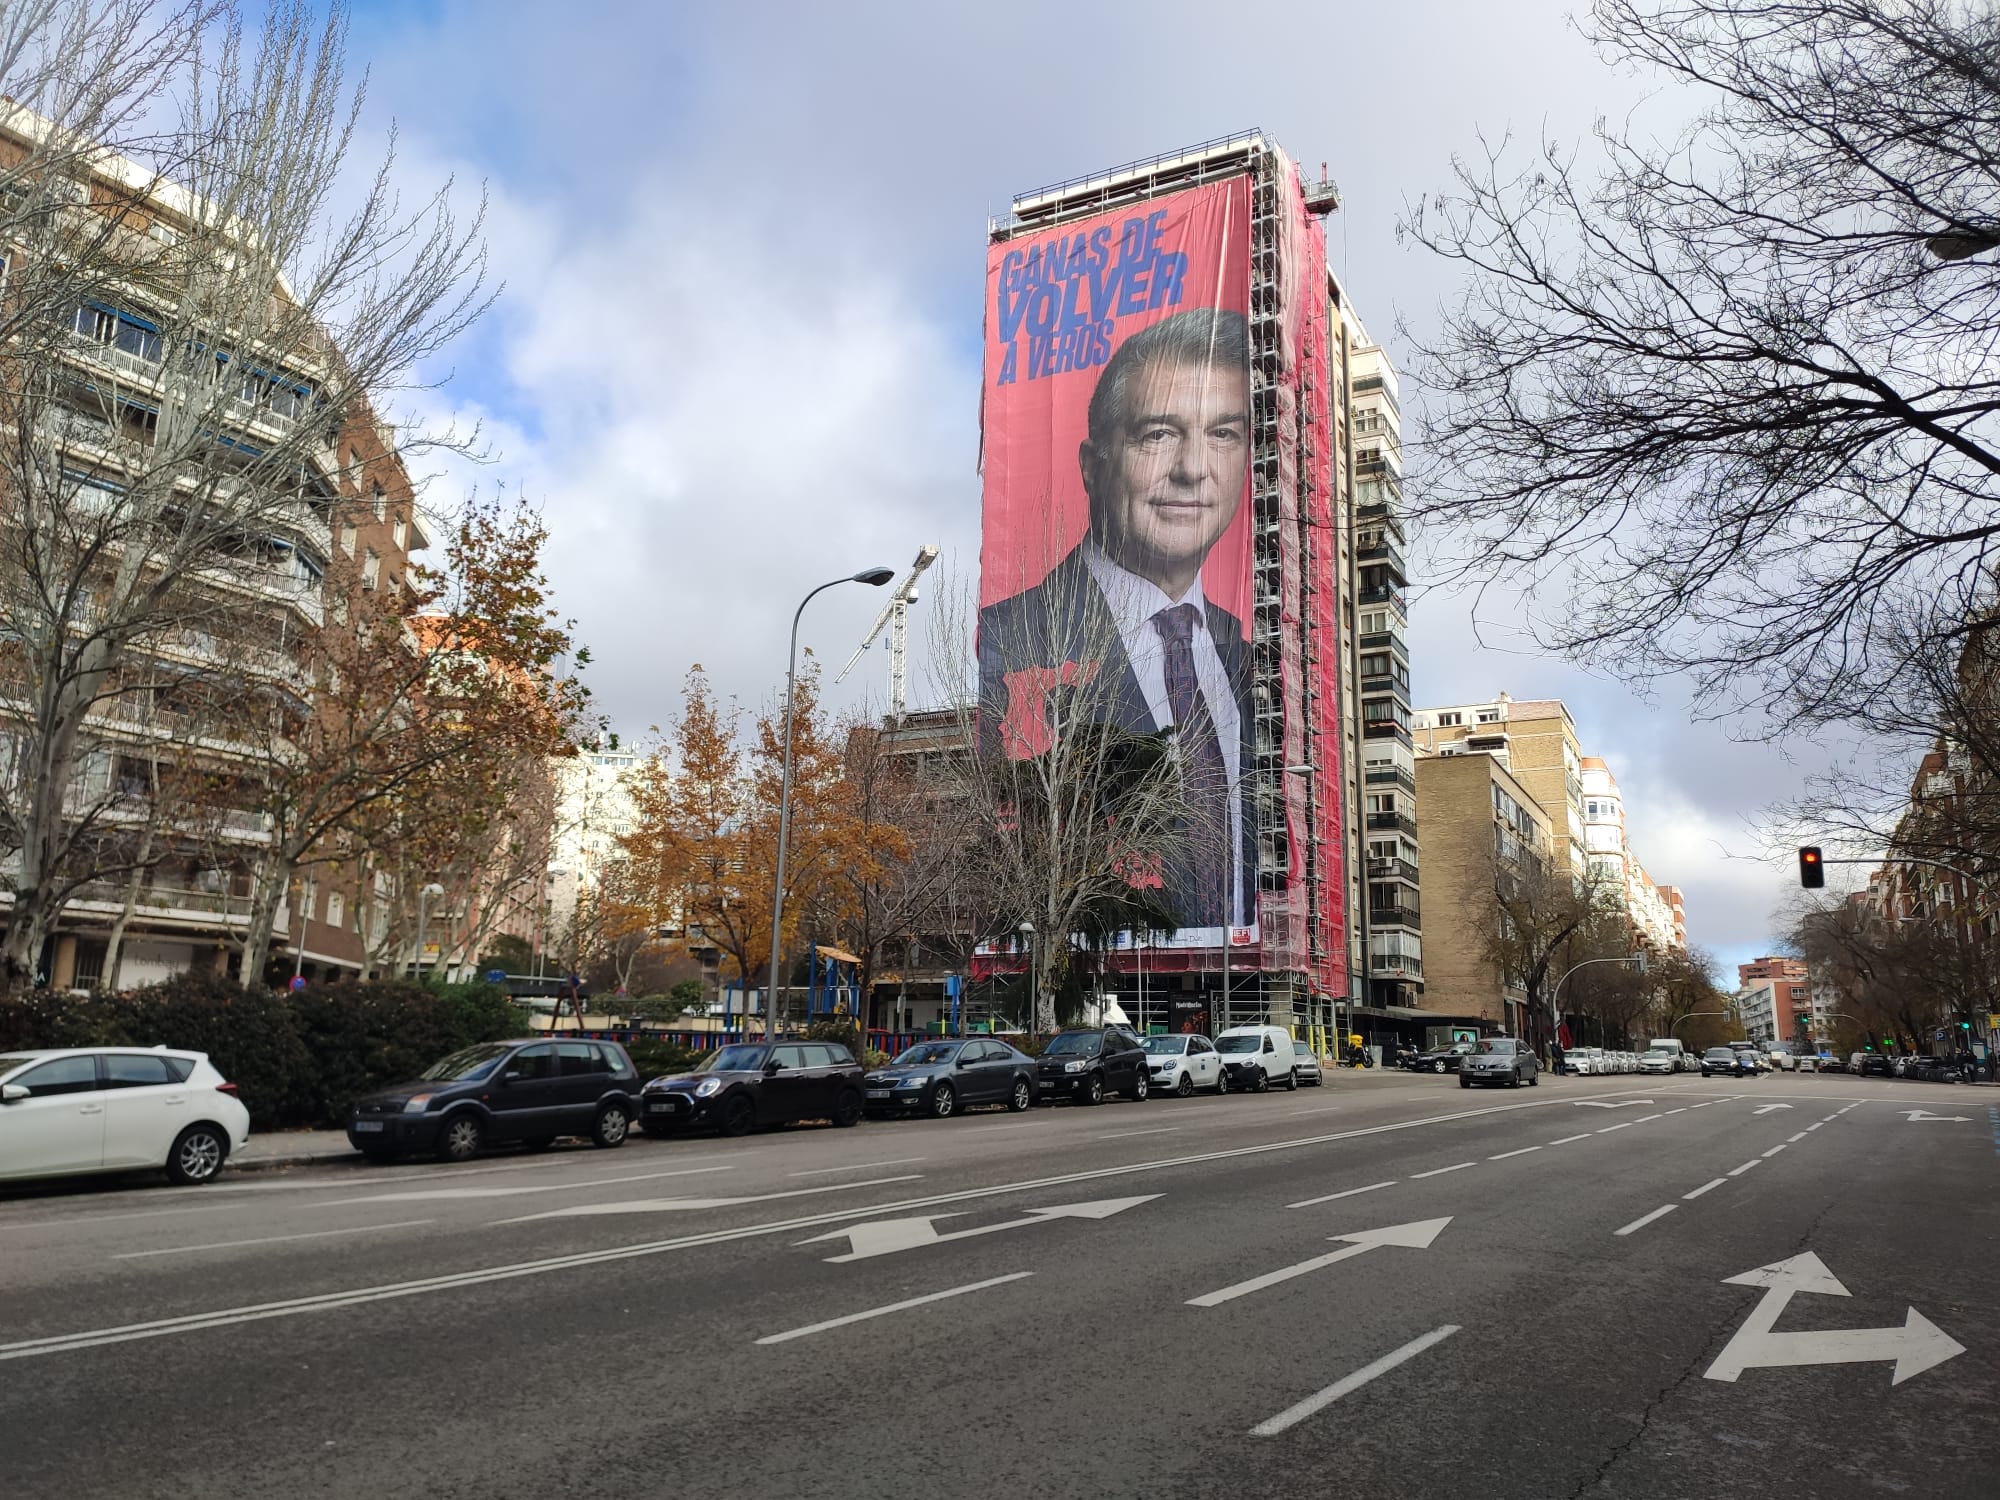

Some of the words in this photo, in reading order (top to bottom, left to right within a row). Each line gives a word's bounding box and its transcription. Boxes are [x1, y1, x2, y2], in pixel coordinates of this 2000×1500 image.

[1001, 226, 1111, 292] GANAS
[1116, 209, 1168, 268] DE
[997, 251, 1188, 343] VOLVER
[997, 339, 1018, 386] A
[1027, 318, 1115, 381] VEROS
